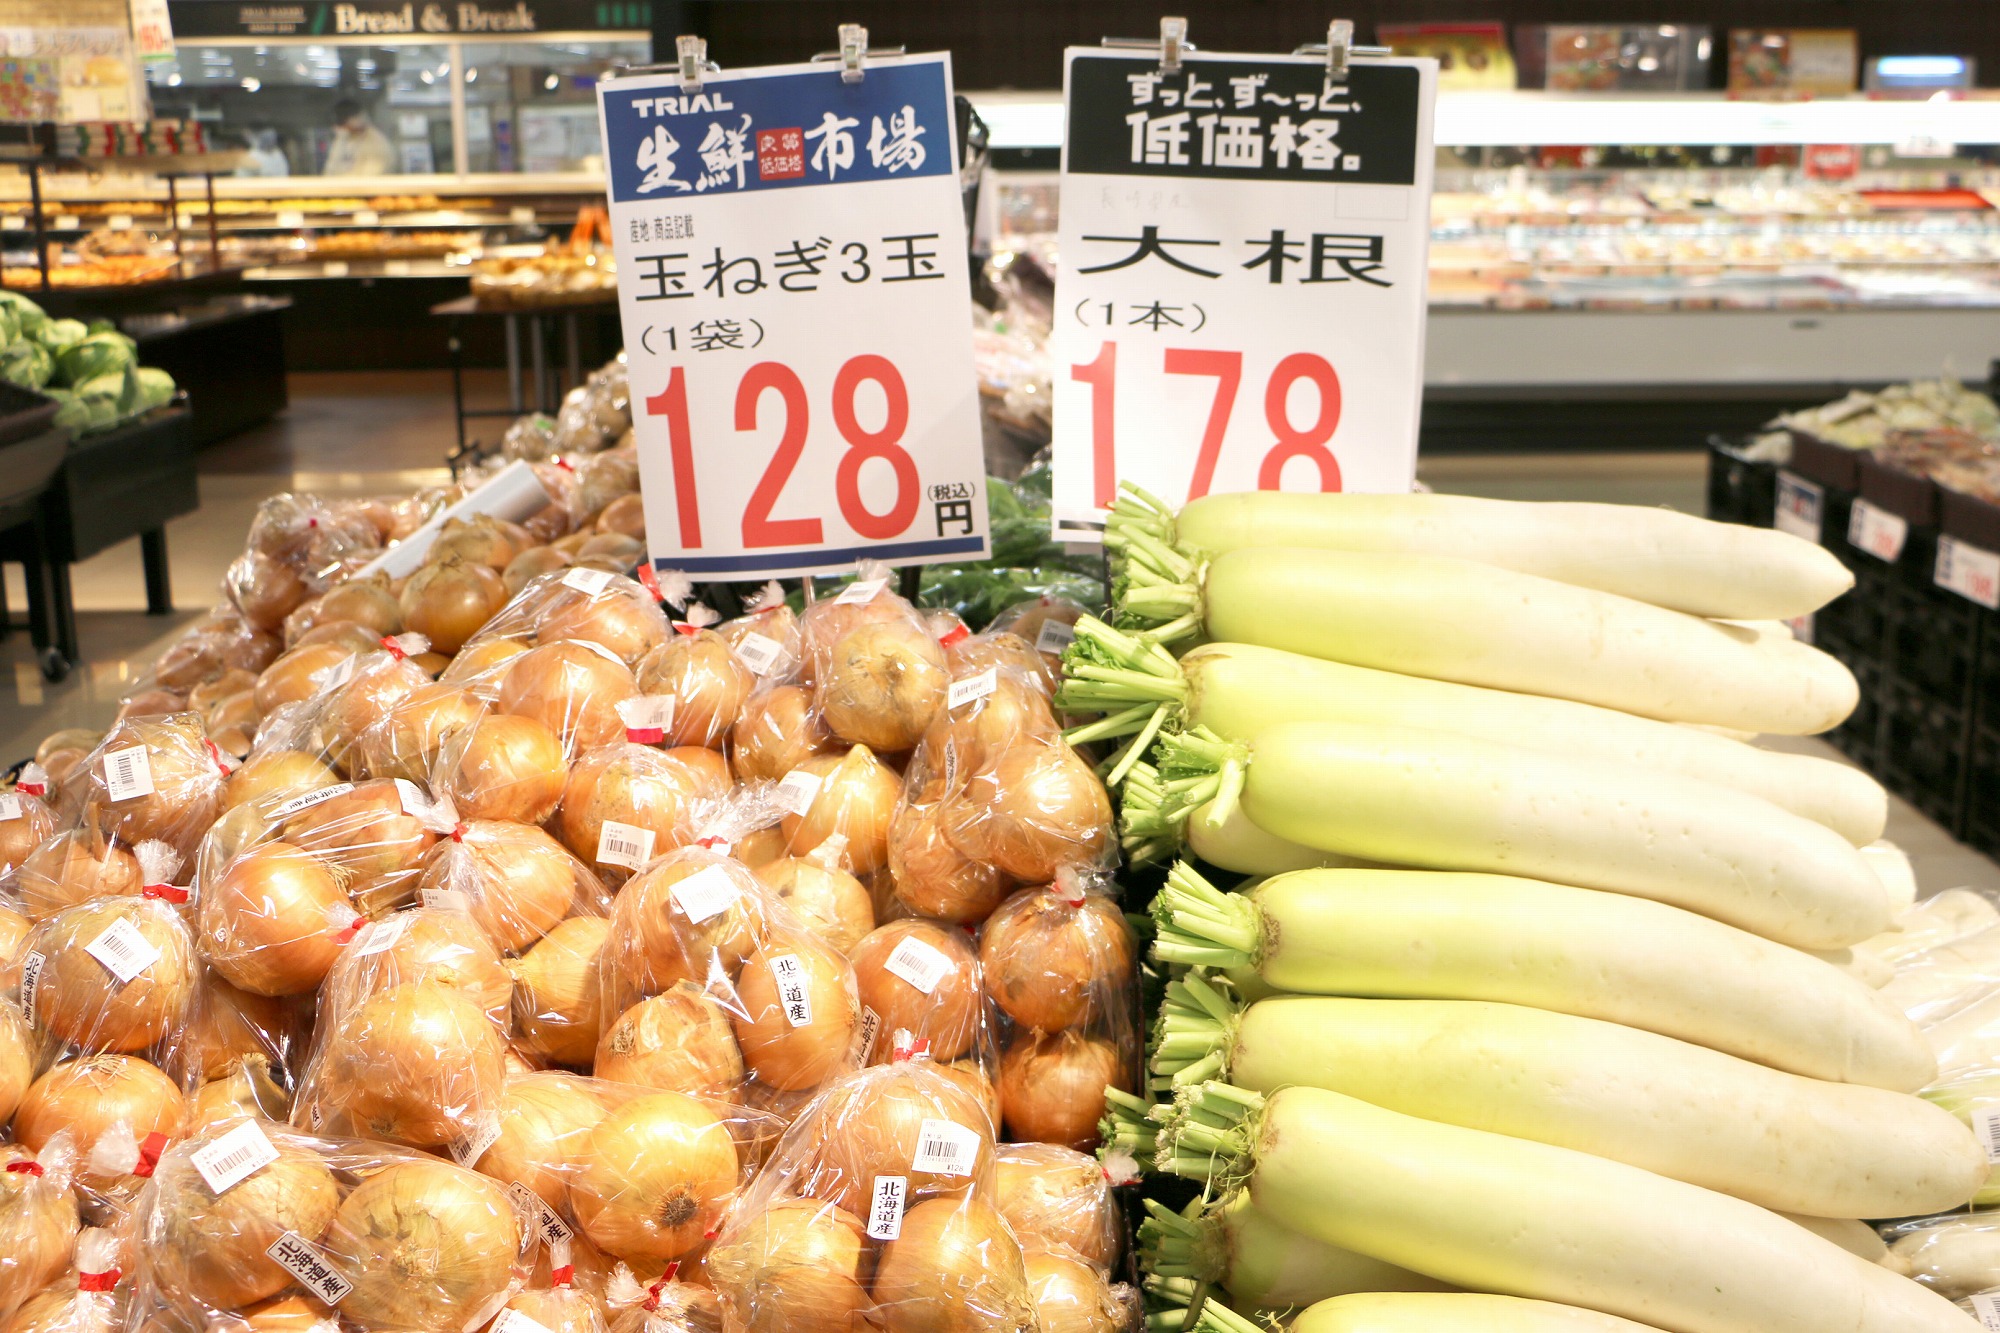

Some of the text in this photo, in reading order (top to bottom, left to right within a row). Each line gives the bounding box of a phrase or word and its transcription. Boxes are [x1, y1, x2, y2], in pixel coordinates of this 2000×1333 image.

[334, 3, 414, 33] Bread
[421, 5, 450, 31] &
[457, 3, 535, 31] Break
[631, 92, 734, 119] TRIAL
[635, 105, 927, 194] 生鮮 市場
[1126, 111, 1362, 172] 低価格。
[634, 233, 946, 303] 玉ねぎ3玉
[1076, 225, 1394, 288] 大根
[645, 353, 921, 549] 128
[1070, 341, 1343, 510] 178
[934, 499, 974, 538] 円
[23, 957, 40, 1023] 北海道産
[873, 1181, 901, 1235] 北海道産
[277, 1240, 345, 1297] 北海道産
